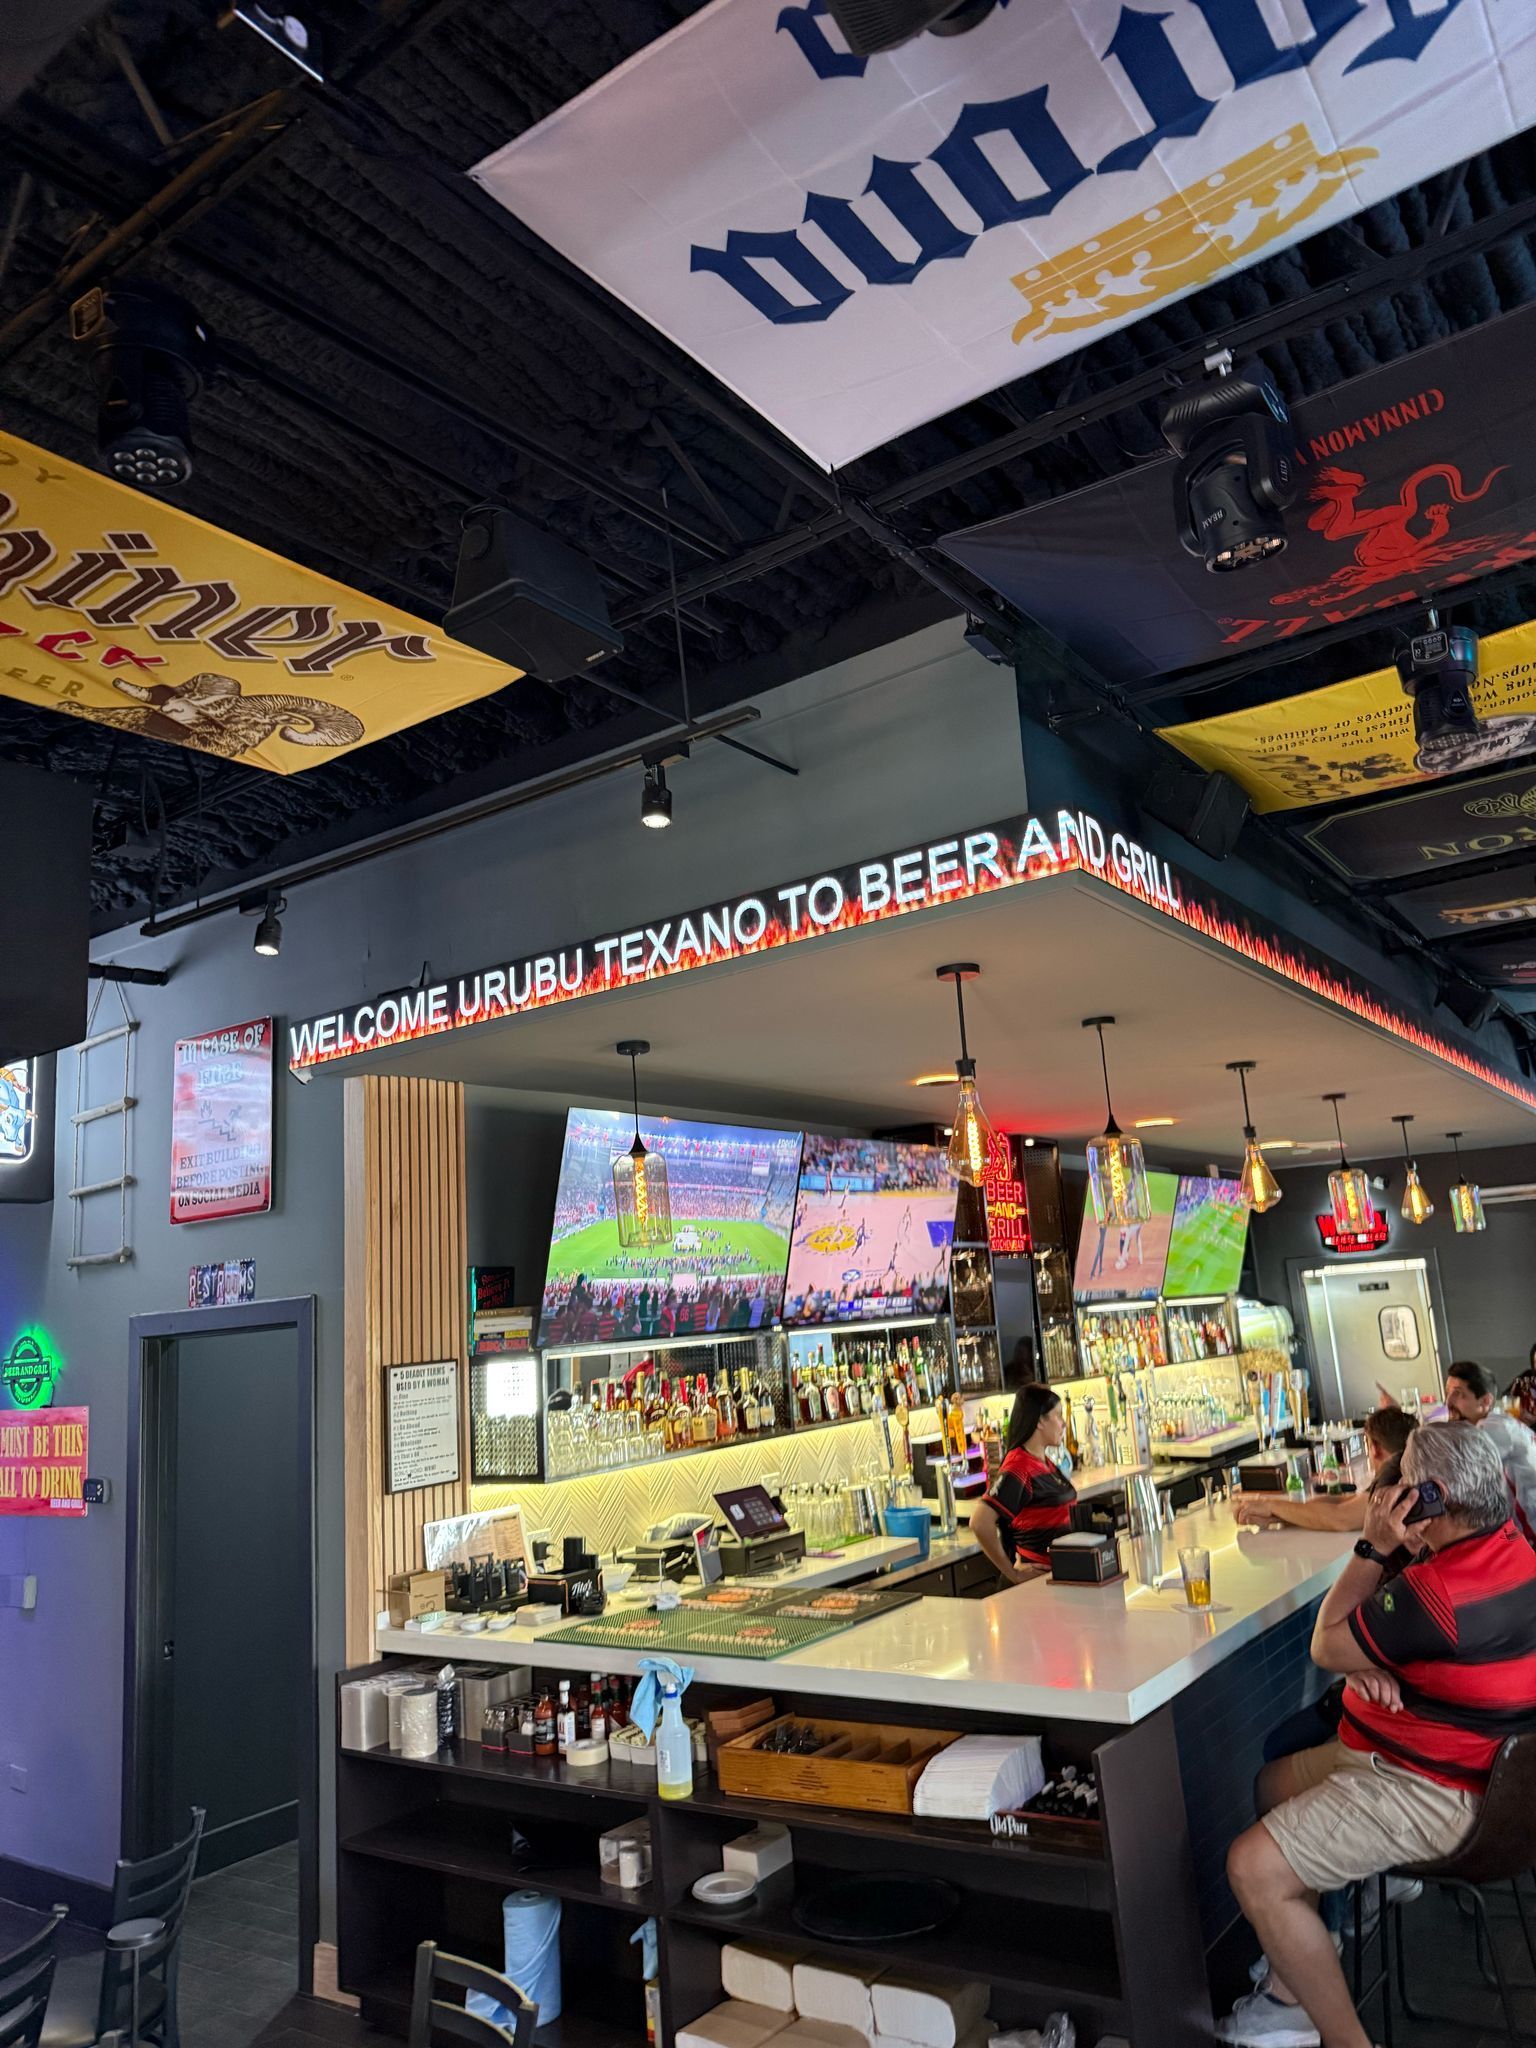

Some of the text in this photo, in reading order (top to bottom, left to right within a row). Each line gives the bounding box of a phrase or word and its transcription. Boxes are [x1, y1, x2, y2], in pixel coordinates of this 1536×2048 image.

[1312, 387, 1446, 458] CINNAMON
[1201, 509, 1224, 530] BEAM
[1334, 720, 1351, 730] or
[1366, 714, 1412, 734] finest
[290, 809, 1180, 1061] WELCOME URUBU TEXANO TO BEER AND GRILL
[201, 1030, 241, 1059] CASE
[244, 1023, 265, 1050] OF
[180, 1142, 263, 1170] EXIT BUILDING
[176, 1163, 264, 1190] BEFORE POSTING
[178, 1181, 261, 1208] ON SOCIAL MEDIA
[986, 1179, 1023, 1203] BEER
[995, 1201, 1017, 1219] AND
[988, 1217, 1027, 1240] GRILL
[189, 1265, 255, 1301] RESTROOMS
[20, 1365, 33, 1376] AND
[406, 1368, 426, 1379] DEADLY
[427, 1366, 445, 1377] TERMS
[396, 1381, 411, 1391] USED
[412, 1380, 421, 1389] BY
[426, 1376, 450, 1388] WOMAN
[0, 1423, 84, 1458] MUST BE THIS
[21, 1465, 37, 1498] TO
[41, 1465, 84, 1499] DRINK
[990, 1813, 1029, 1838] Old Parr
